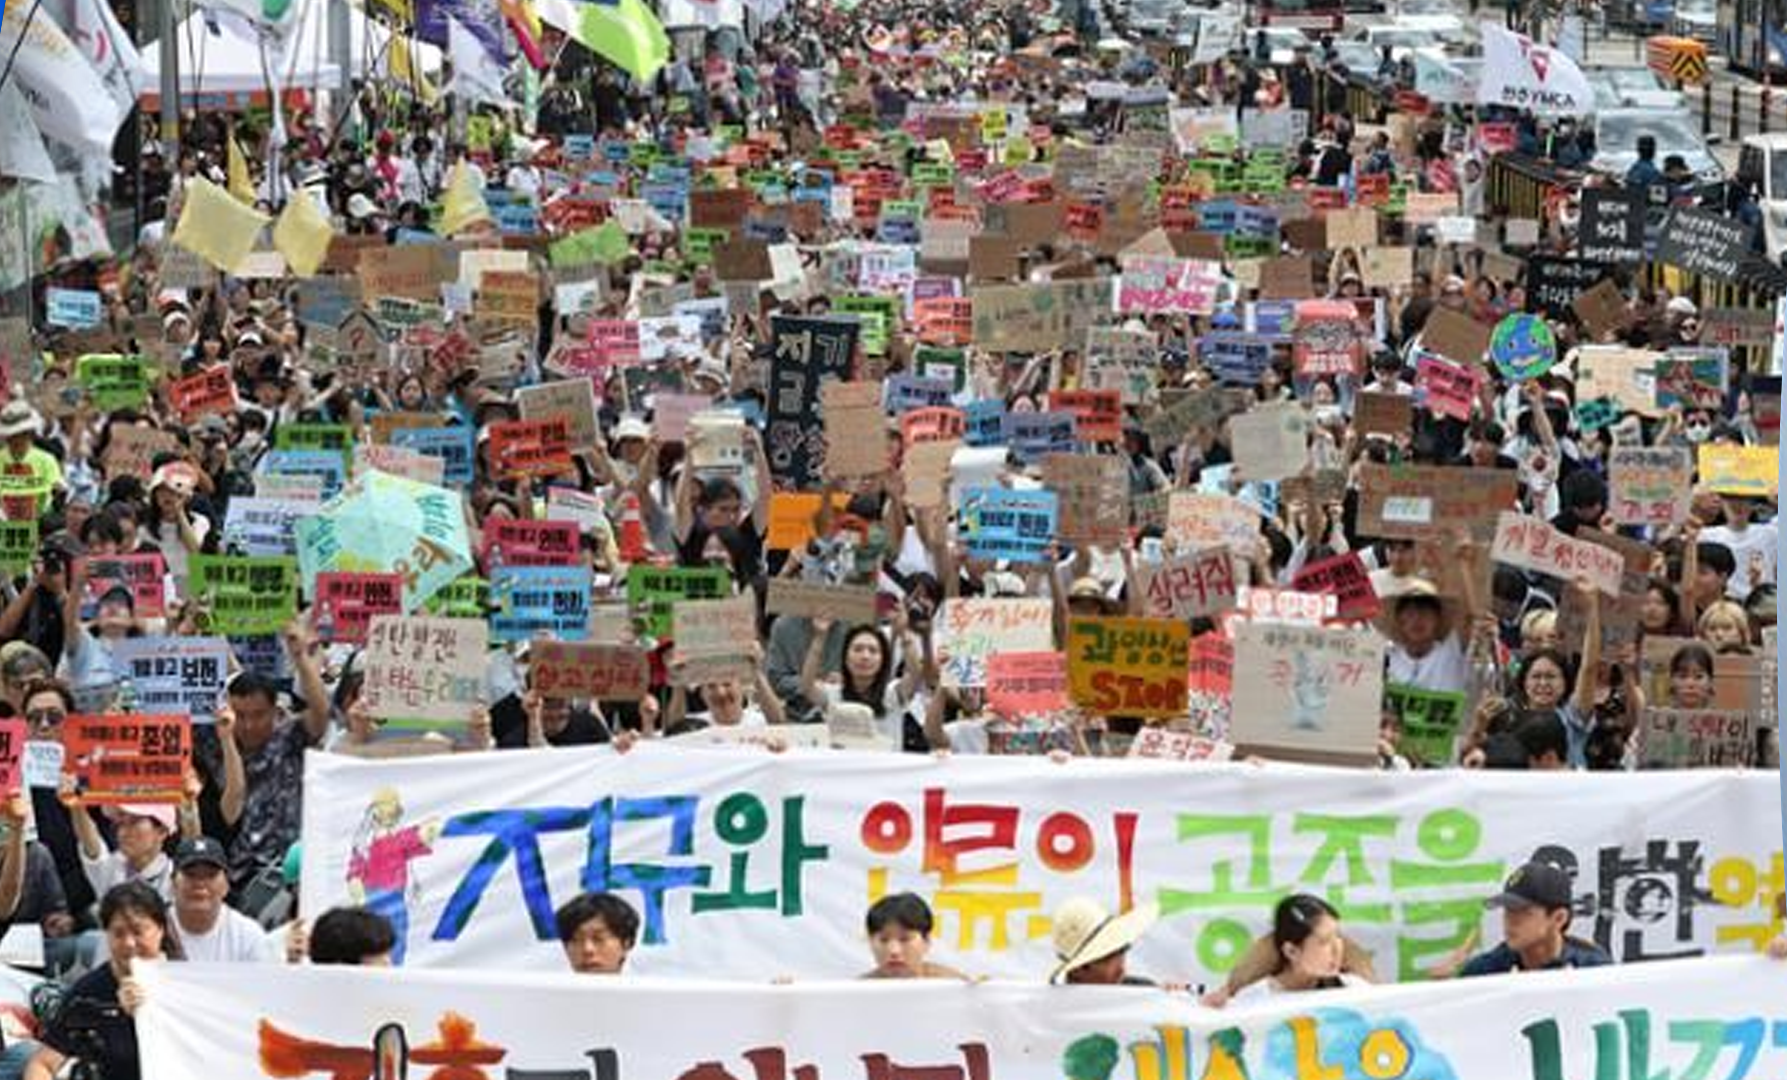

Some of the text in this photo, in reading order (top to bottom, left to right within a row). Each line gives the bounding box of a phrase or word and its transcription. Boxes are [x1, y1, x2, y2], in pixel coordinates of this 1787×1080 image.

[1090, 671, 1186, 711] STOP
[142, 723, 188, 757] 존엄,
[432, 791, 829, 944] 지구와
[1156, 806, 1508, 983] 공존을
